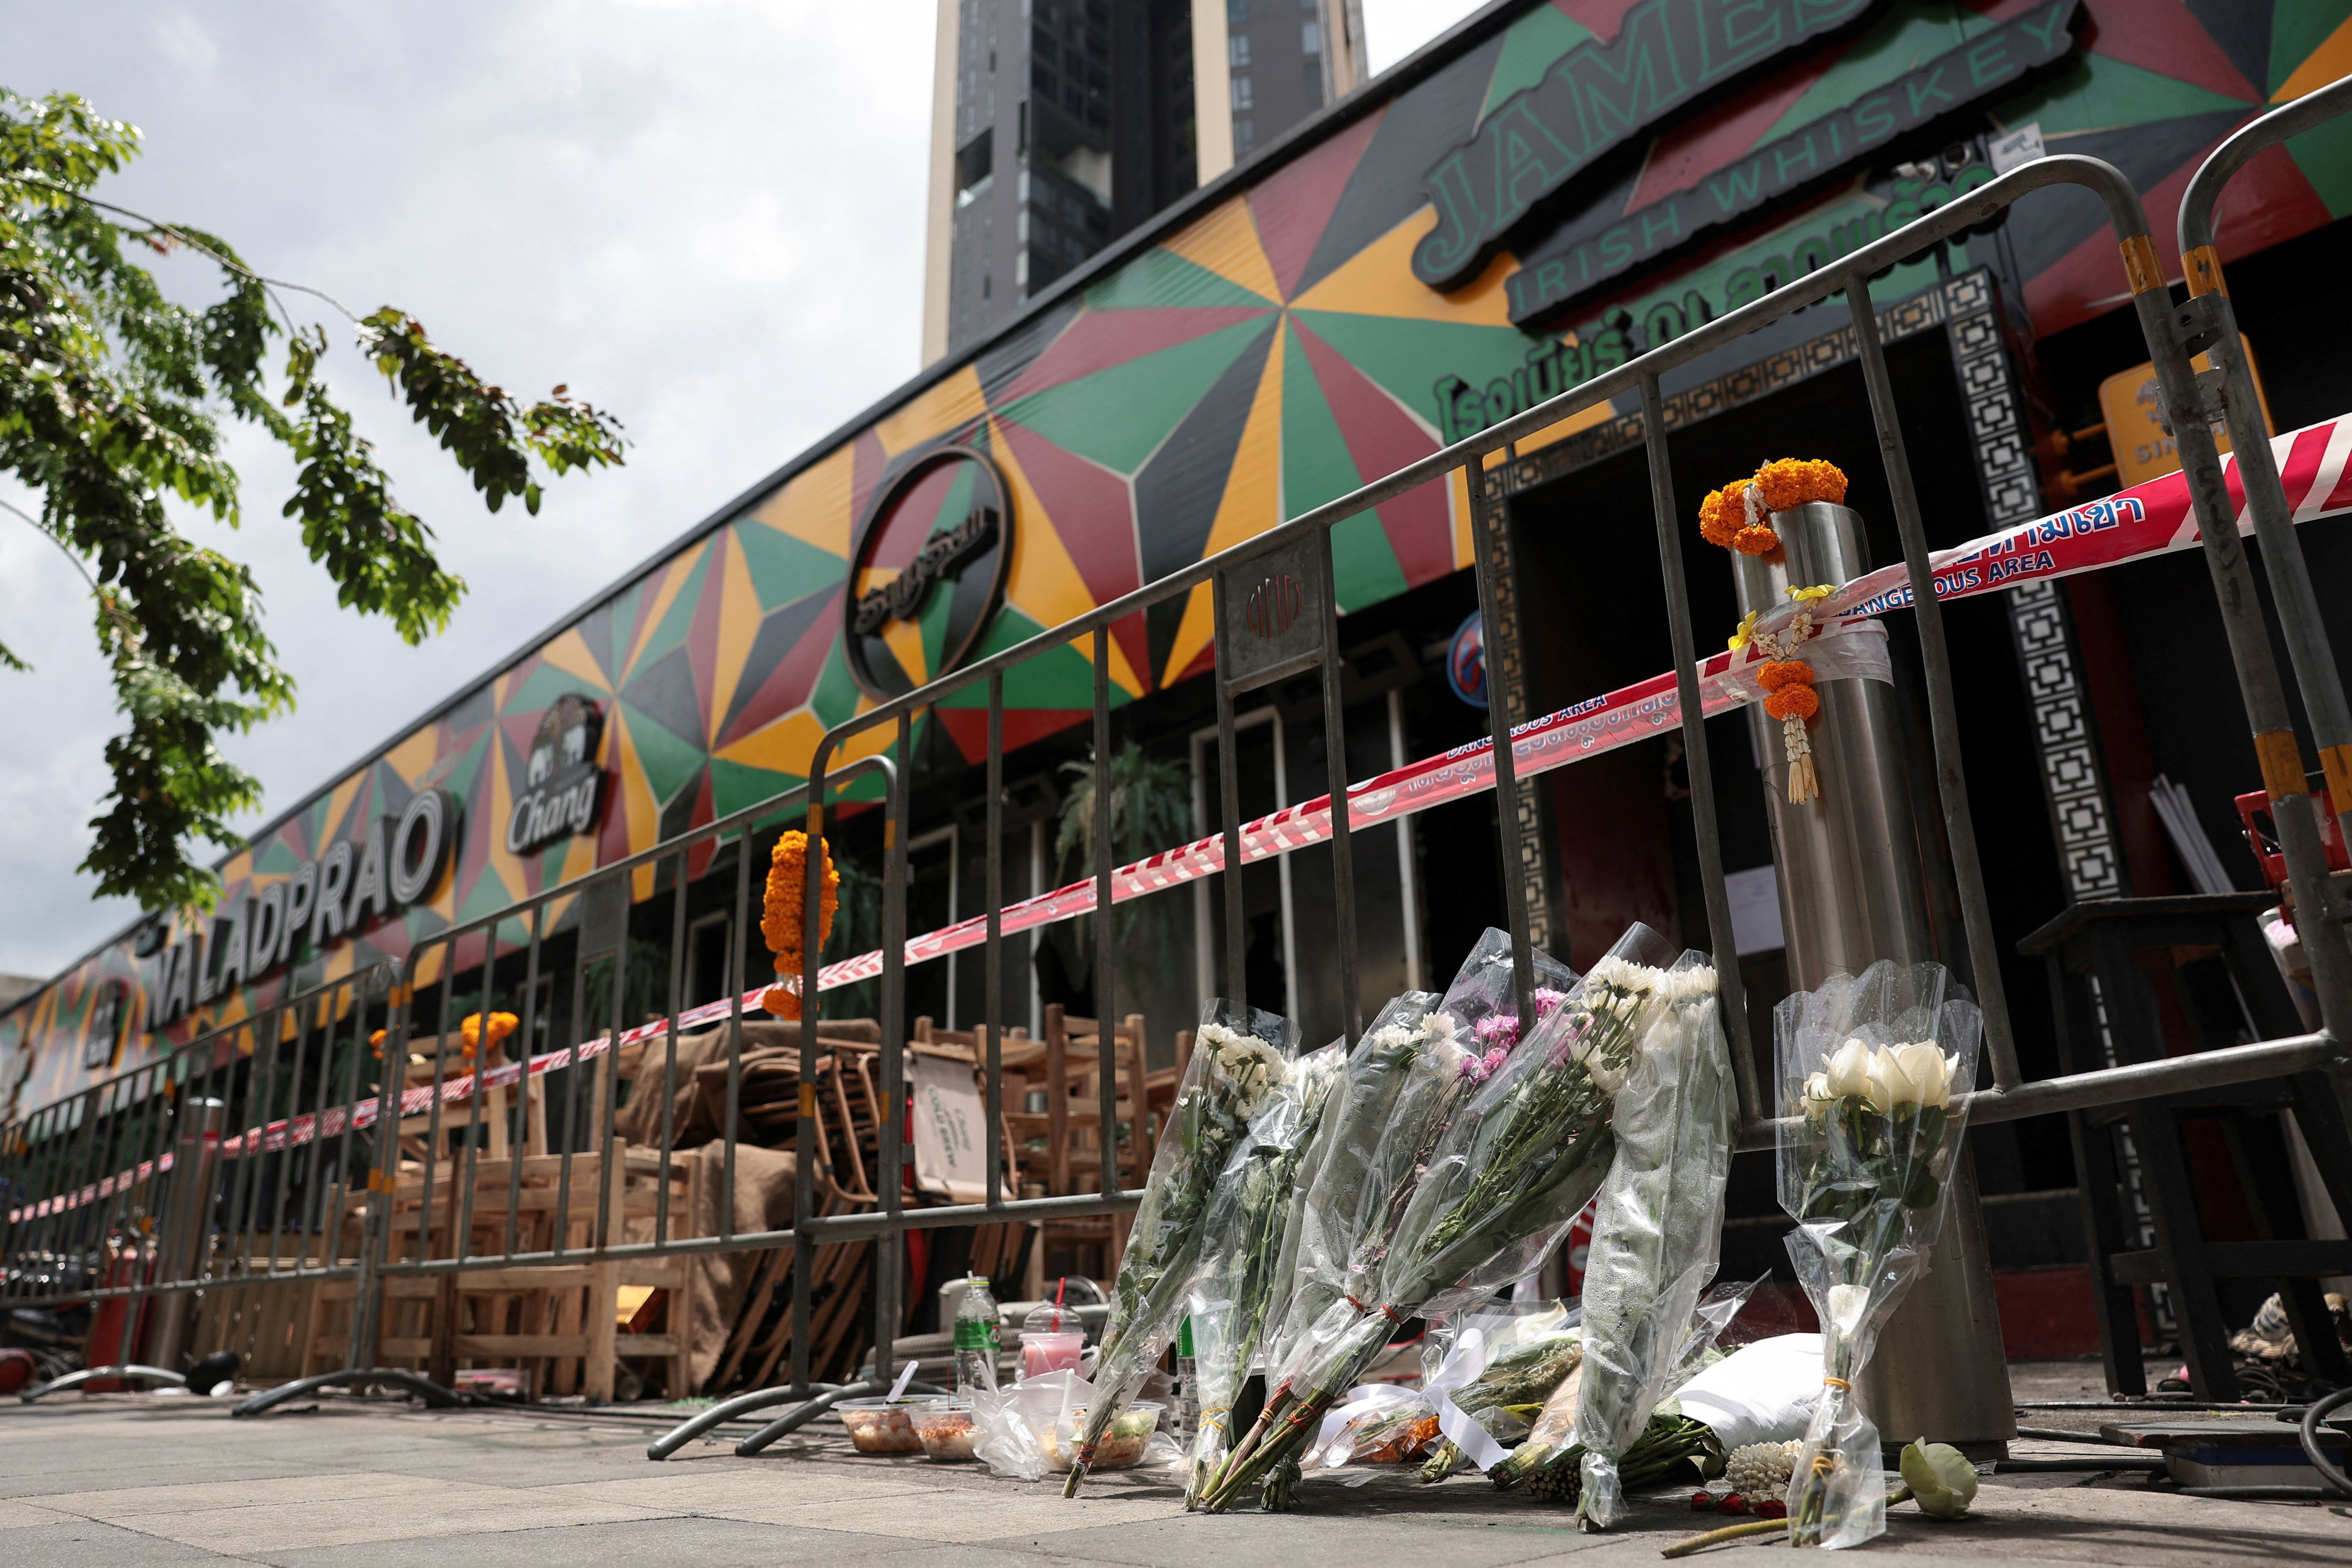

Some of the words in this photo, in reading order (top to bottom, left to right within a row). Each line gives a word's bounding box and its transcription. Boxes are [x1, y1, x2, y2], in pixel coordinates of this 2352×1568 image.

[1514, 203, 1681, 313] IRISH
[1709, 7, 2061, 212] WHISKEY
[1838, 567, 1982, 617] DANGEOUS
[1988, 551, 2055, 584] AREA
[1558, 694, 1607, 721] AREA
[508, 775, 597, 854] Chang
